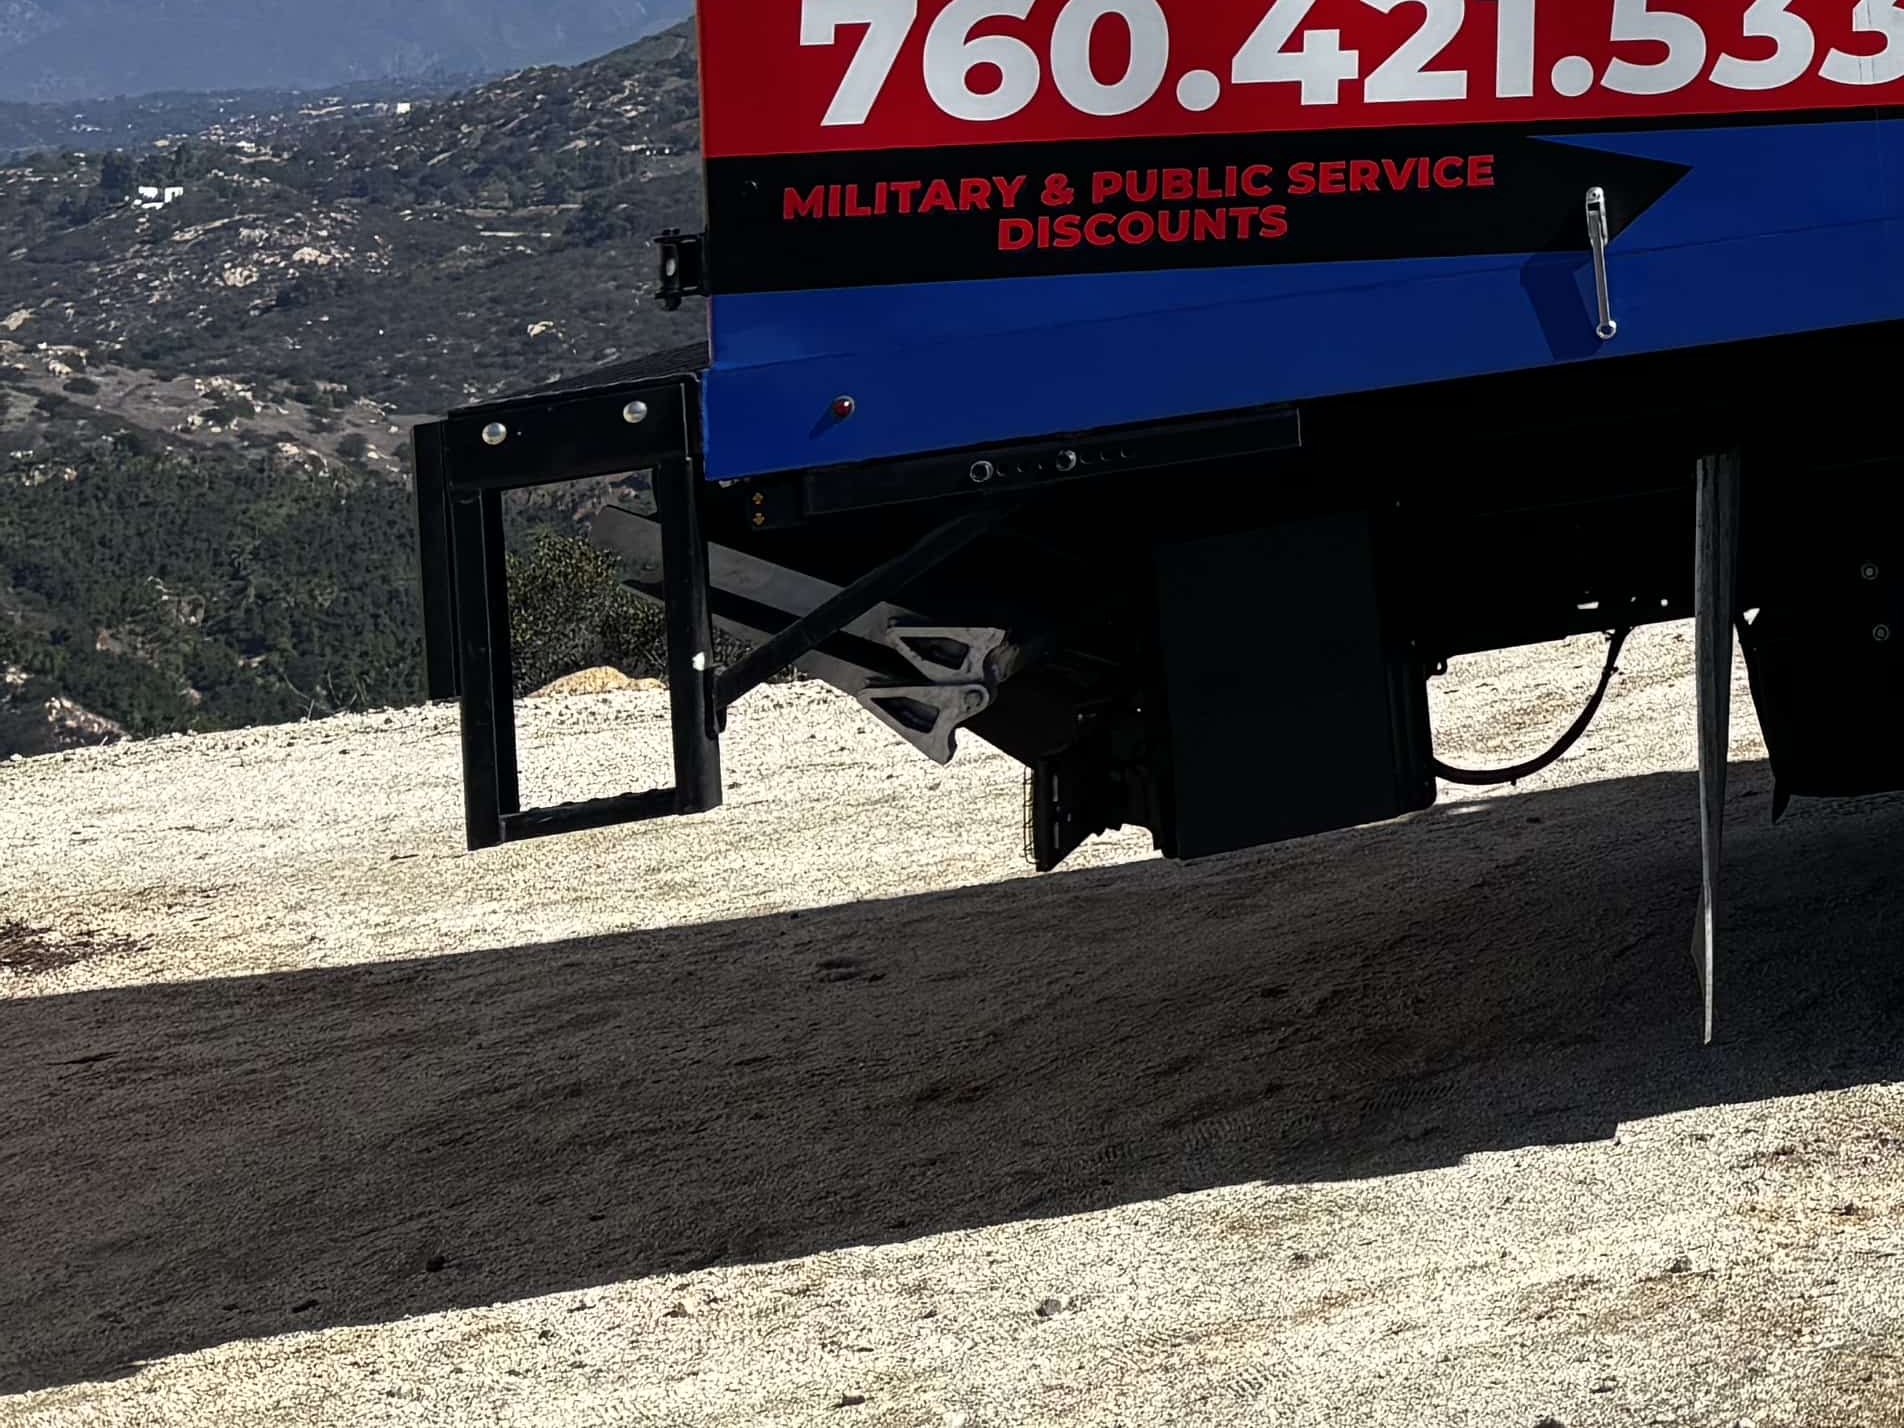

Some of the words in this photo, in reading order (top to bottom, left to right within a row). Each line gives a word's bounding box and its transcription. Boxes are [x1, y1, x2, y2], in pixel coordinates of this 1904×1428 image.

[783, 173, 1027, 220] MILITARY
[1040, 170, 1075, 207] &
[1090, 162, 1275, 204] PUBLIC
[1285, 154, 1496, 197] SERVICE
[997, 205, 1290, 251] DISCOUNTS
